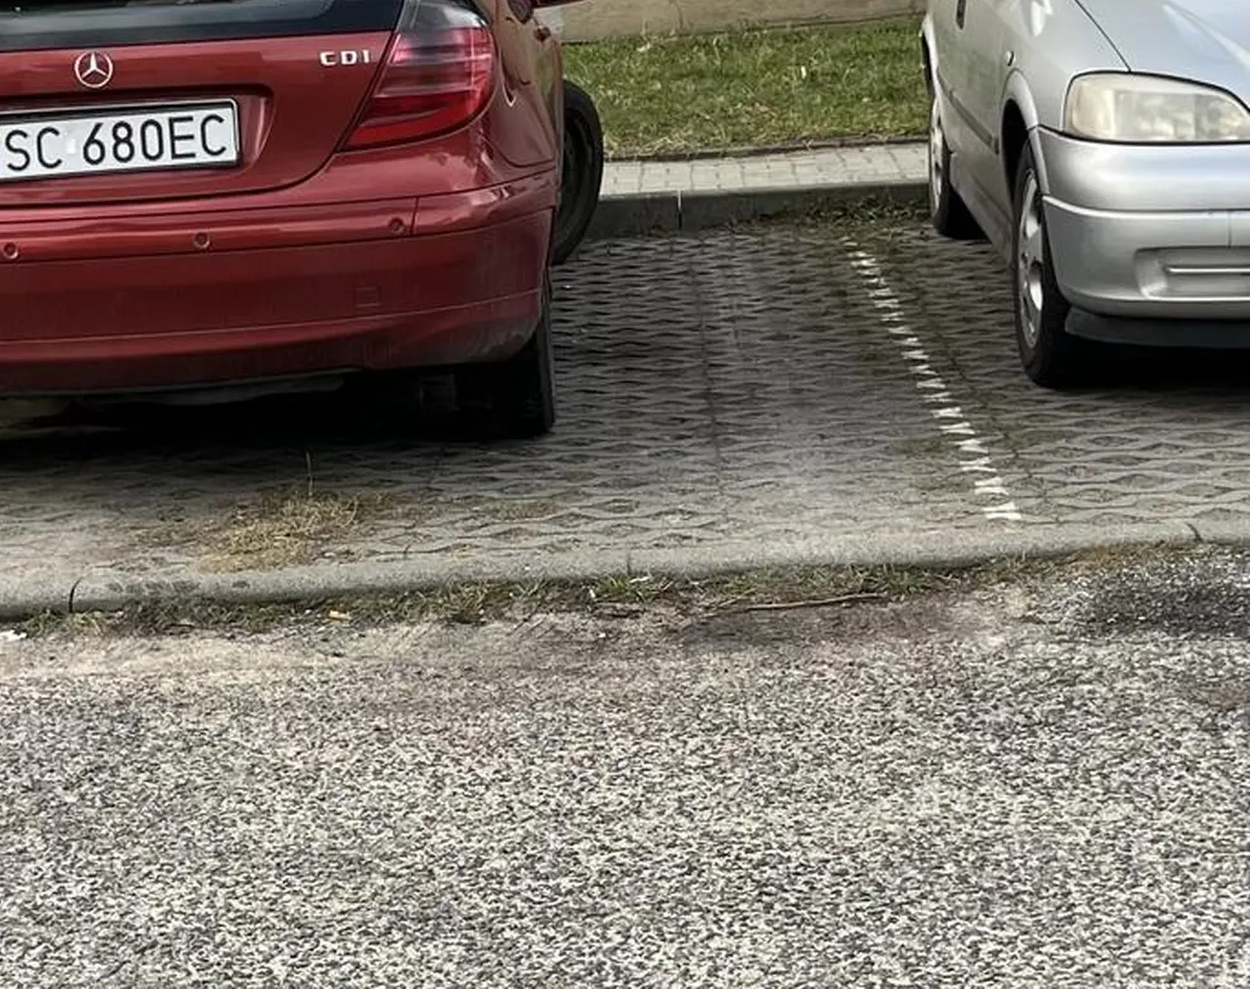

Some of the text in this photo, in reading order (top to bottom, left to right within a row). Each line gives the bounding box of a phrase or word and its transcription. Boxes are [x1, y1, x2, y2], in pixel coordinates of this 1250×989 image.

[319, 49, 370, 66] CDI
[5, 114, 227, 171] SC 680EC
